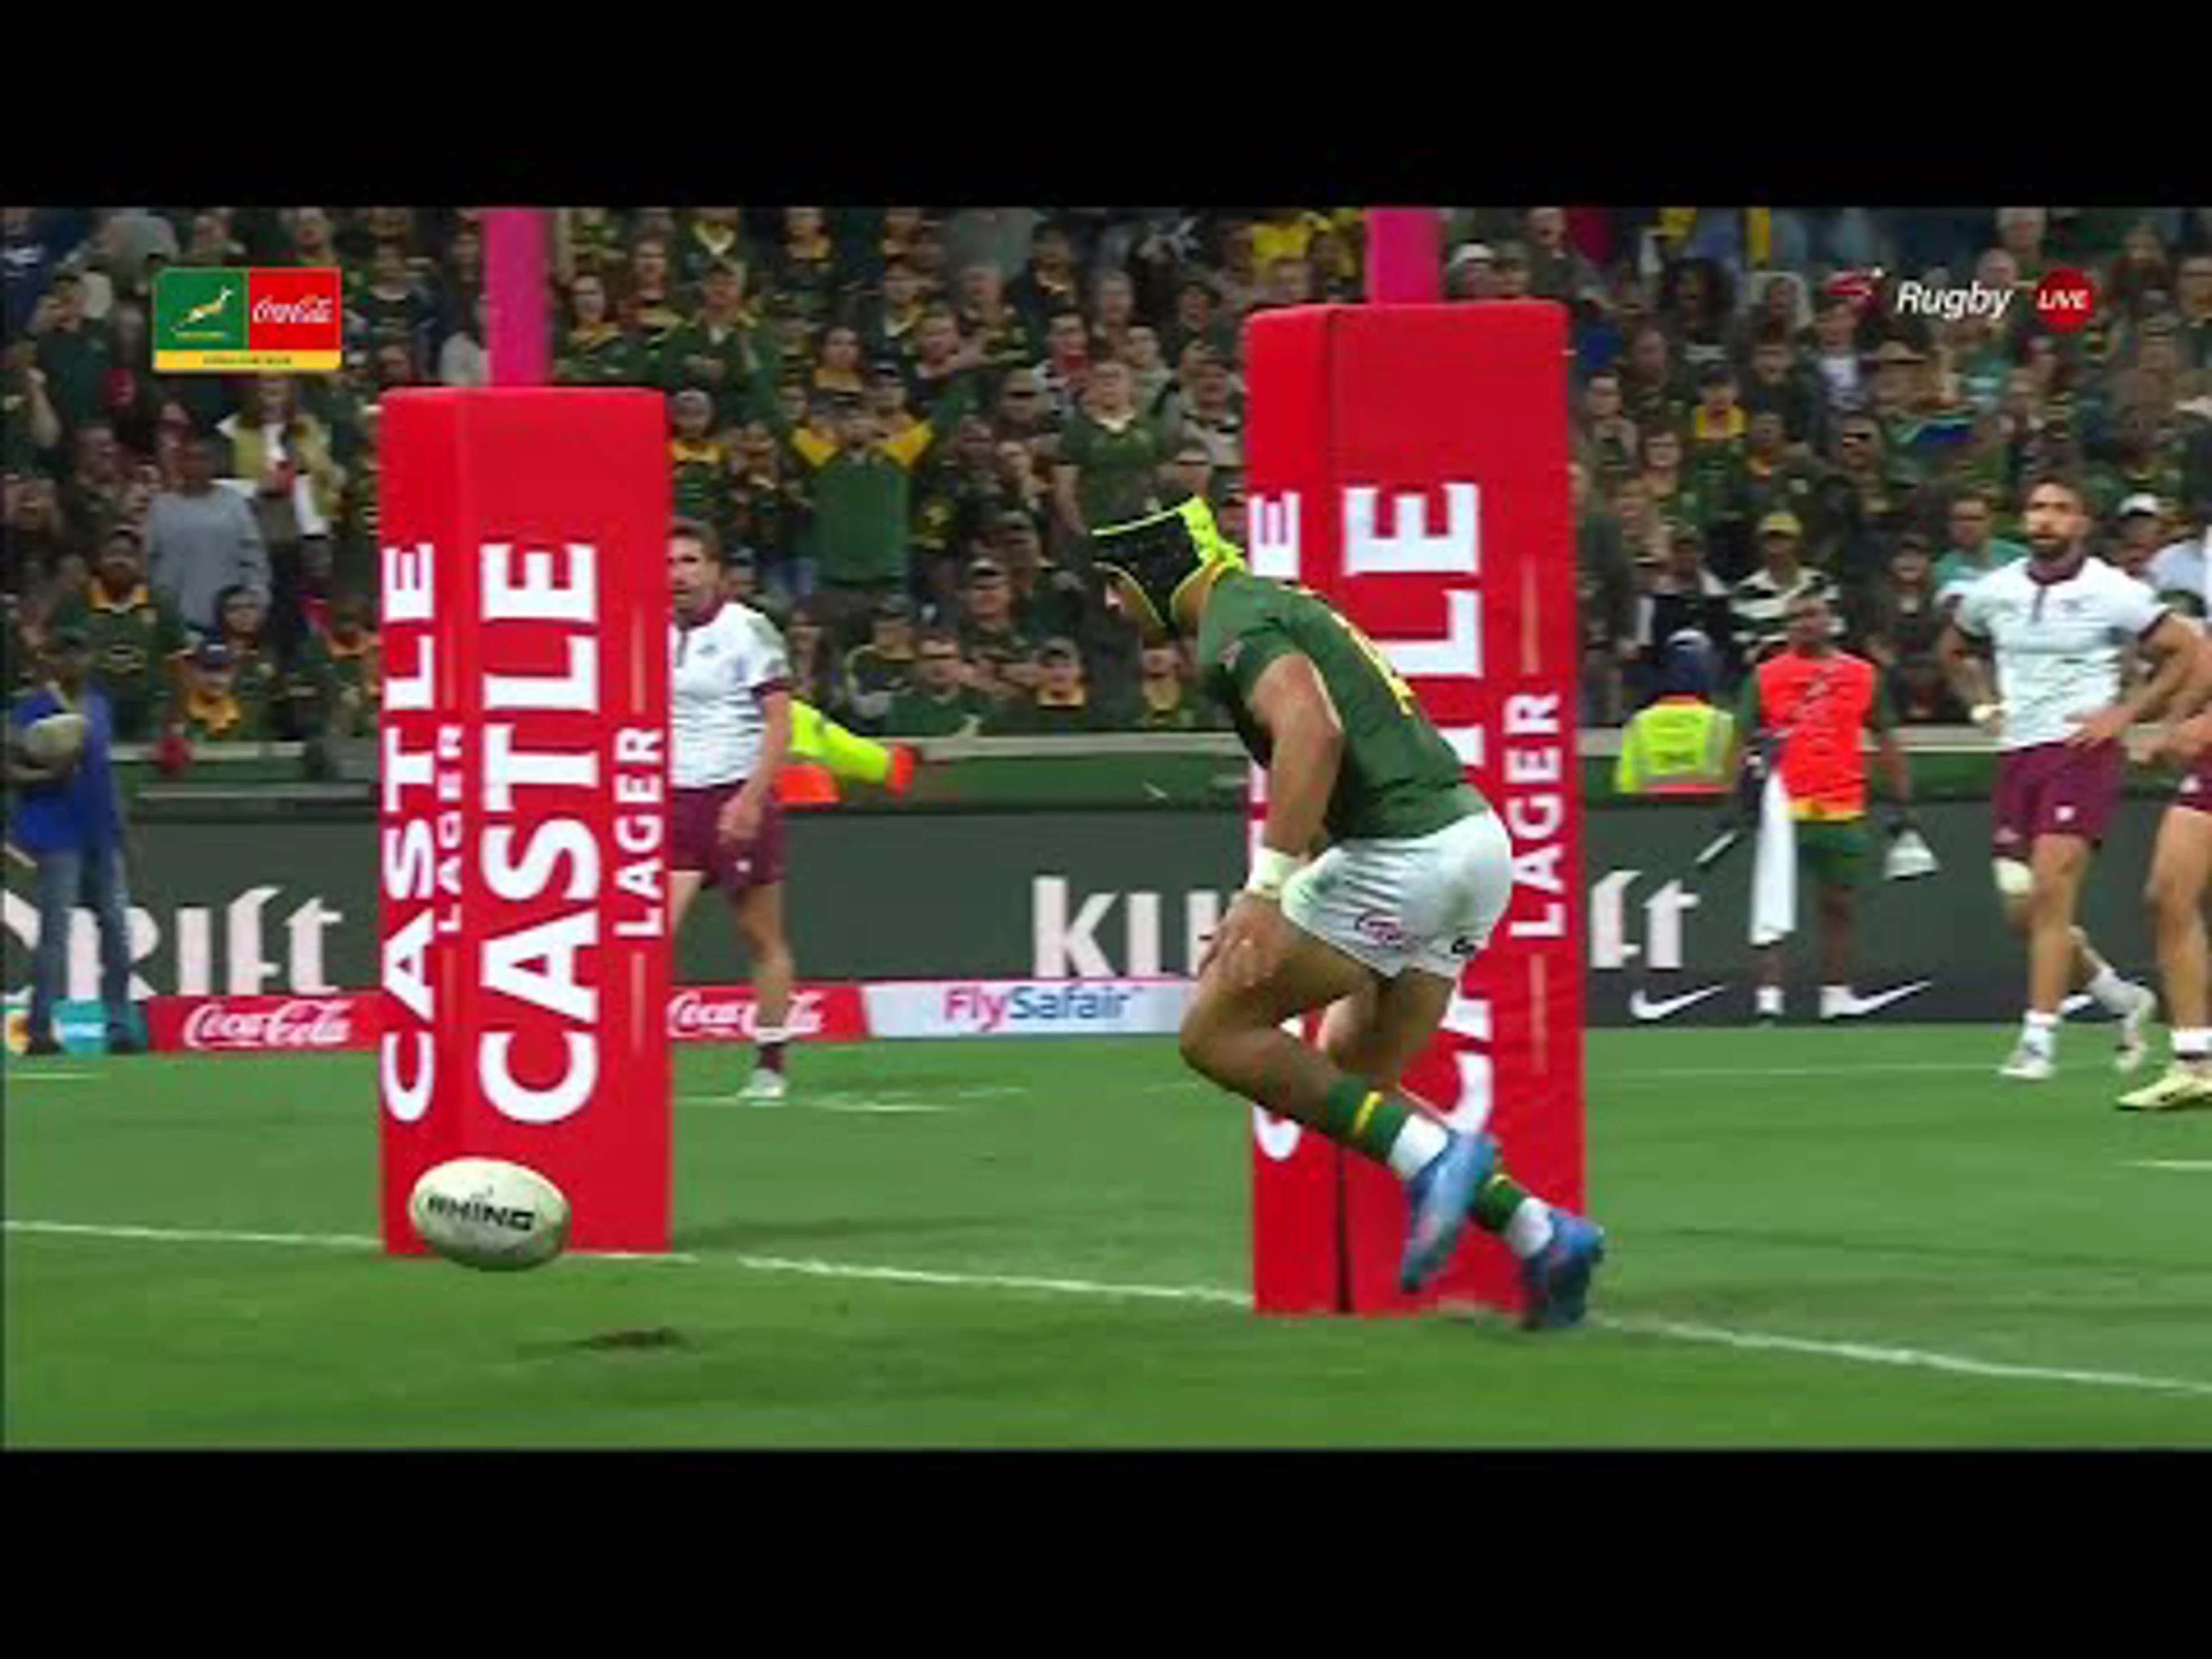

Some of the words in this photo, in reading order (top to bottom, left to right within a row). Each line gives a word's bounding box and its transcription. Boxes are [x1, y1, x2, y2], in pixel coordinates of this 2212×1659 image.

[382, 543, 434, 1122] CASTLE
[437, 723, 462, 933] LAGER
[479, 542, 599, 1123] CASTLE
[613, 727, 665, 937] LAGER
[1503, 693, 1566, 937] LAGER
[183, 1000, 354, 1051] Coca-Cola
